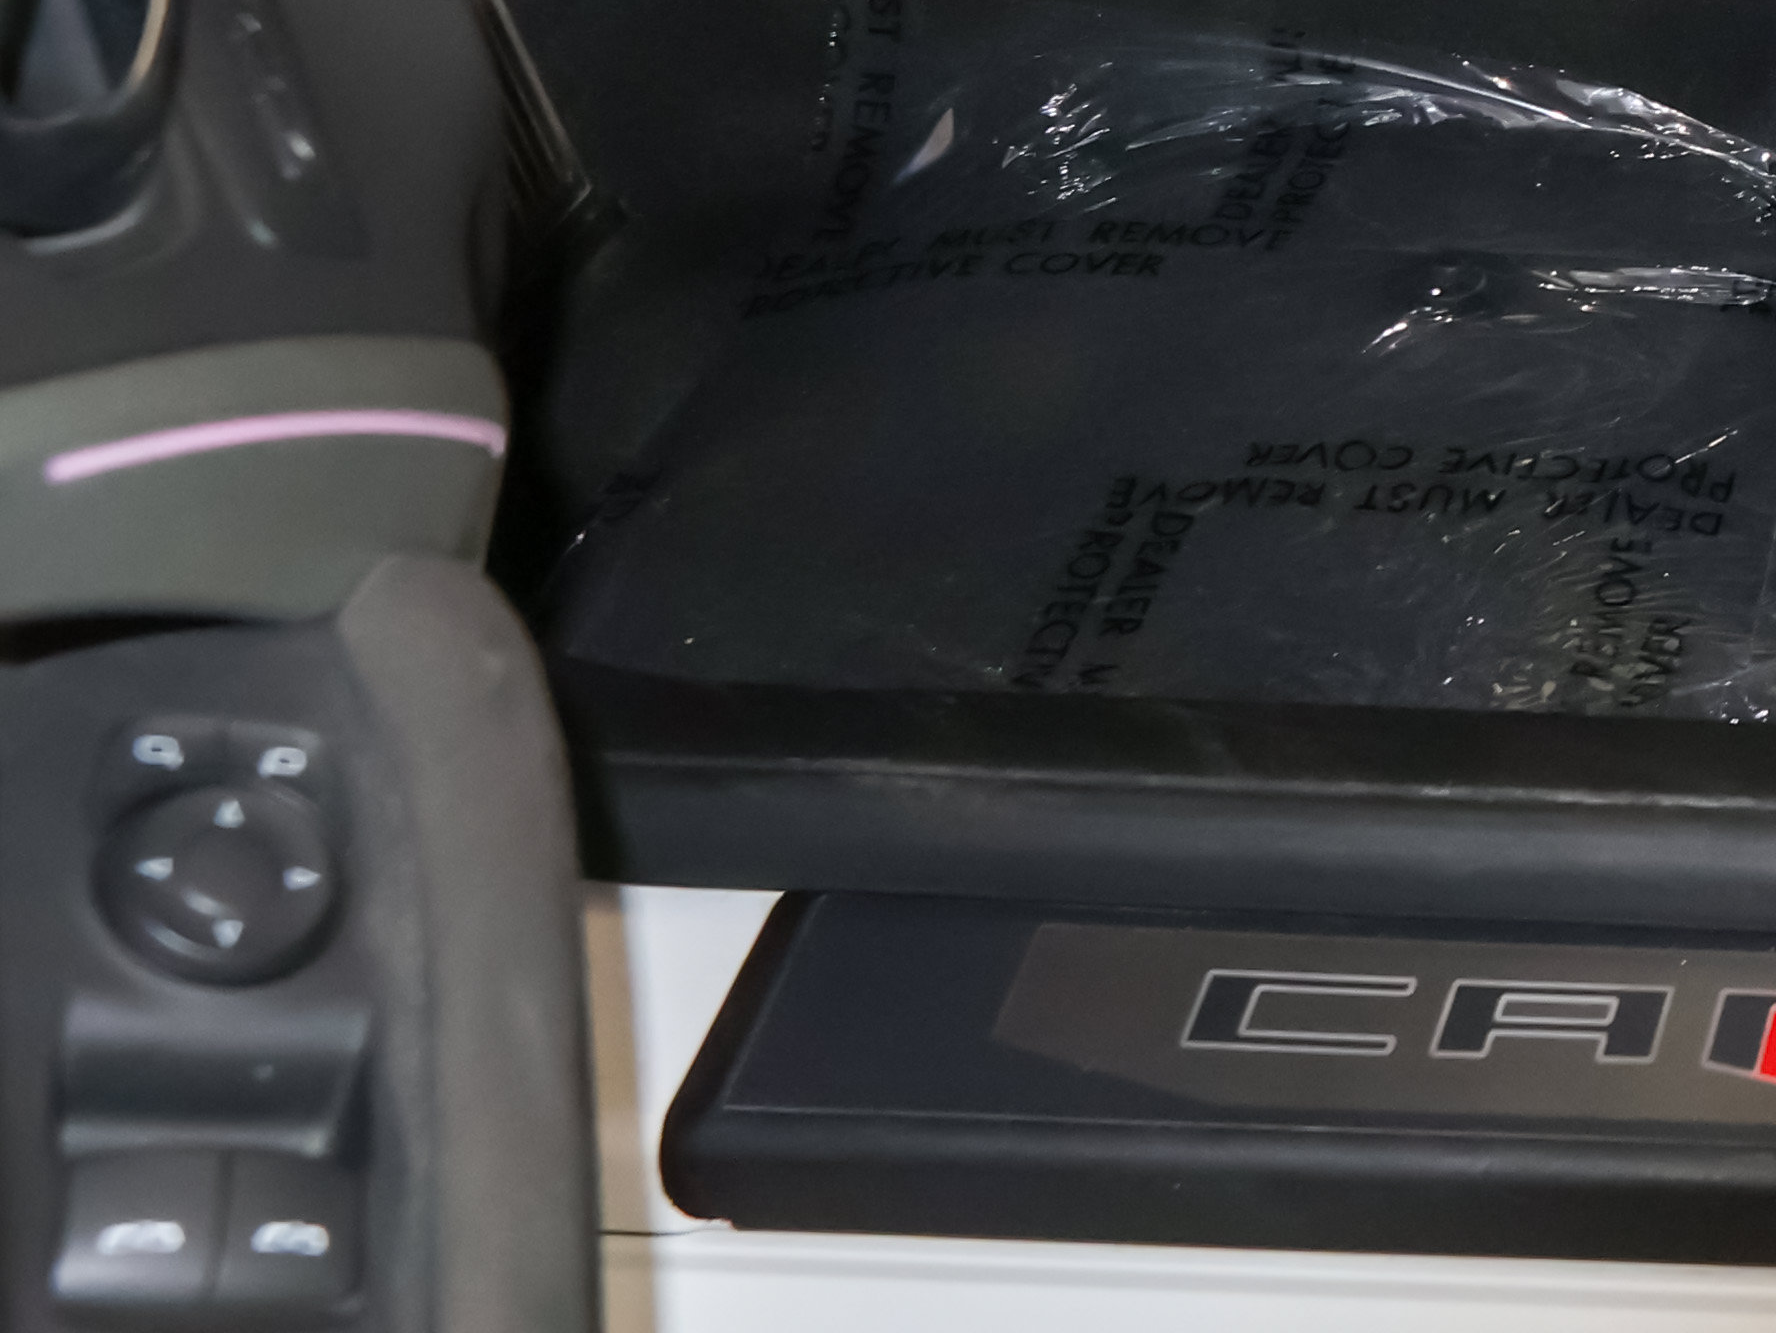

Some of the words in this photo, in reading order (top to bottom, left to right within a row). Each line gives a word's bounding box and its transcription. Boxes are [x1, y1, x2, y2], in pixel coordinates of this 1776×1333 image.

[1003, 252, 1164, 277] COVER
[1247, 442, 1410, 472] COVER
[1355, 484, 1505, 517] MUST
[1098, 505, 1195, 645] DEALER
